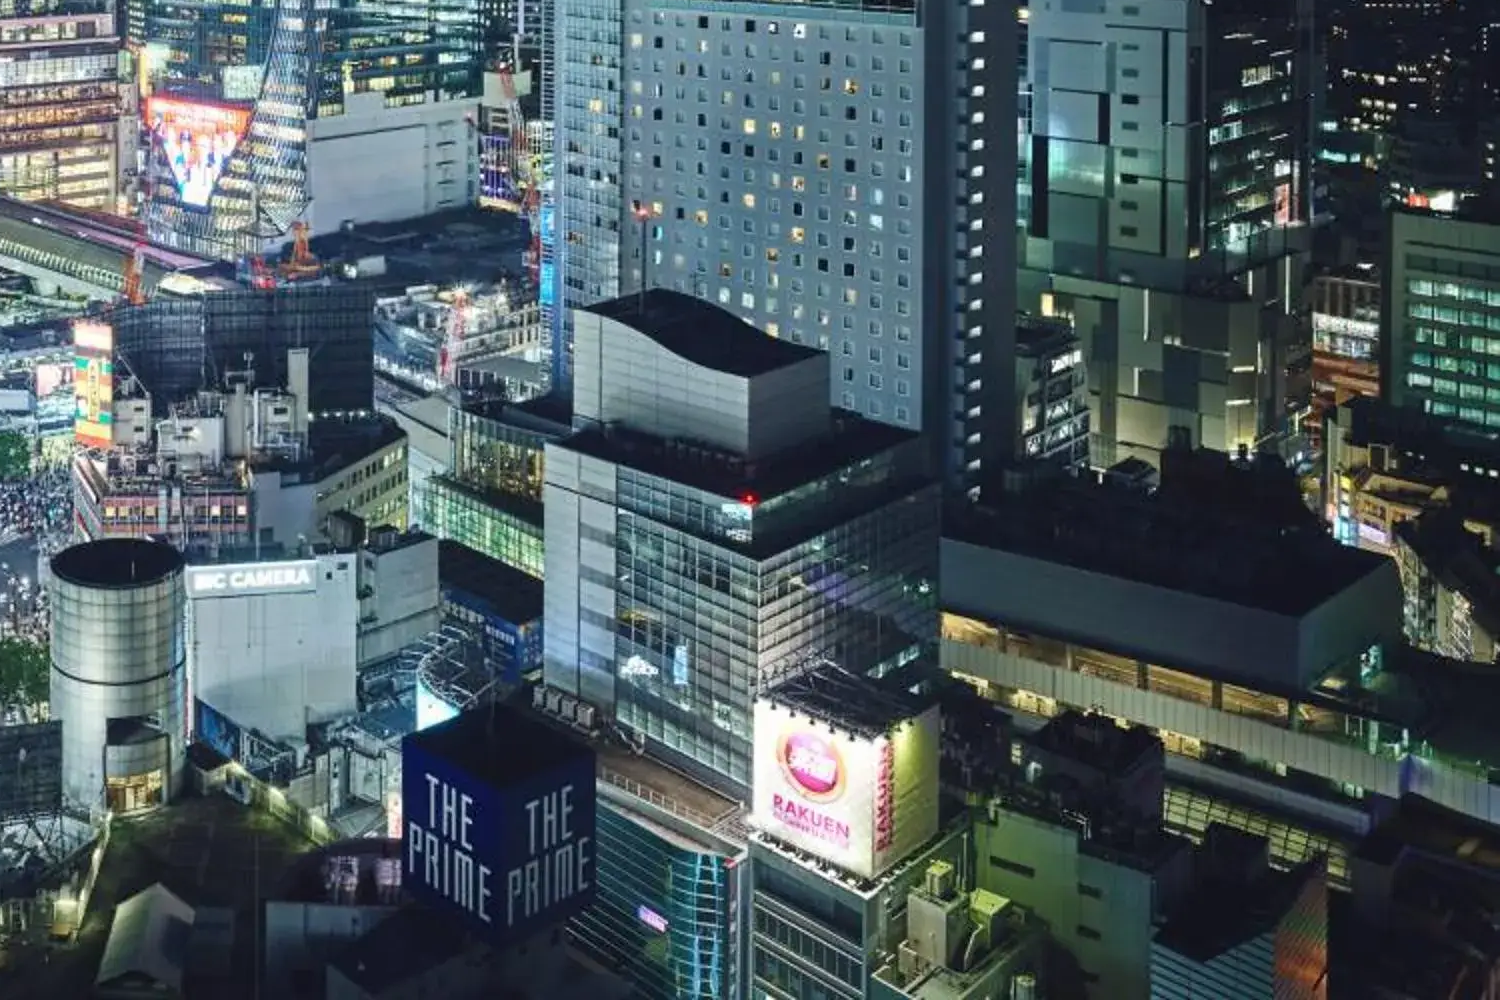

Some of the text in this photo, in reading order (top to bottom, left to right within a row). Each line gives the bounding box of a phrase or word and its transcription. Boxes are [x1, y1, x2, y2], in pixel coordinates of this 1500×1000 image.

[229, 567, 311, 589] CAMERA
[425, 773, 474, 850] THE
[524, 785, 574, 855] THE
[773, 792, 850, 839] RAKUEN
[409, 821, 492, 923] PRIME
[507, 836, 591, 926] PRIME
